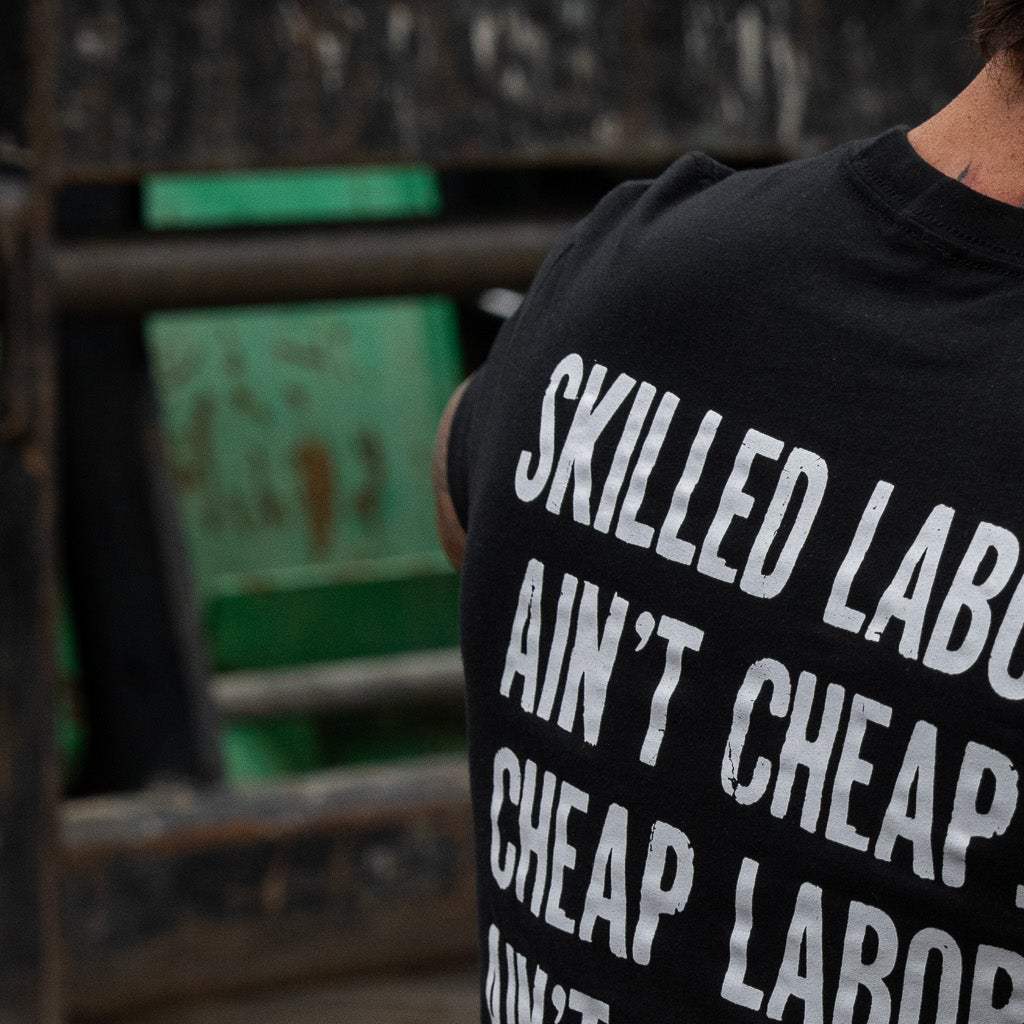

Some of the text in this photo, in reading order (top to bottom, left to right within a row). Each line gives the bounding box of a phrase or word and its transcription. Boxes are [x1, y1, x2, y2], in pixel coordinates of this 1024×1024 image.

[514, 352, 829, 600] SKILLED
[499, 557, 705, 767] AIN'T
[489, 746, 695, 966] CHEAP
